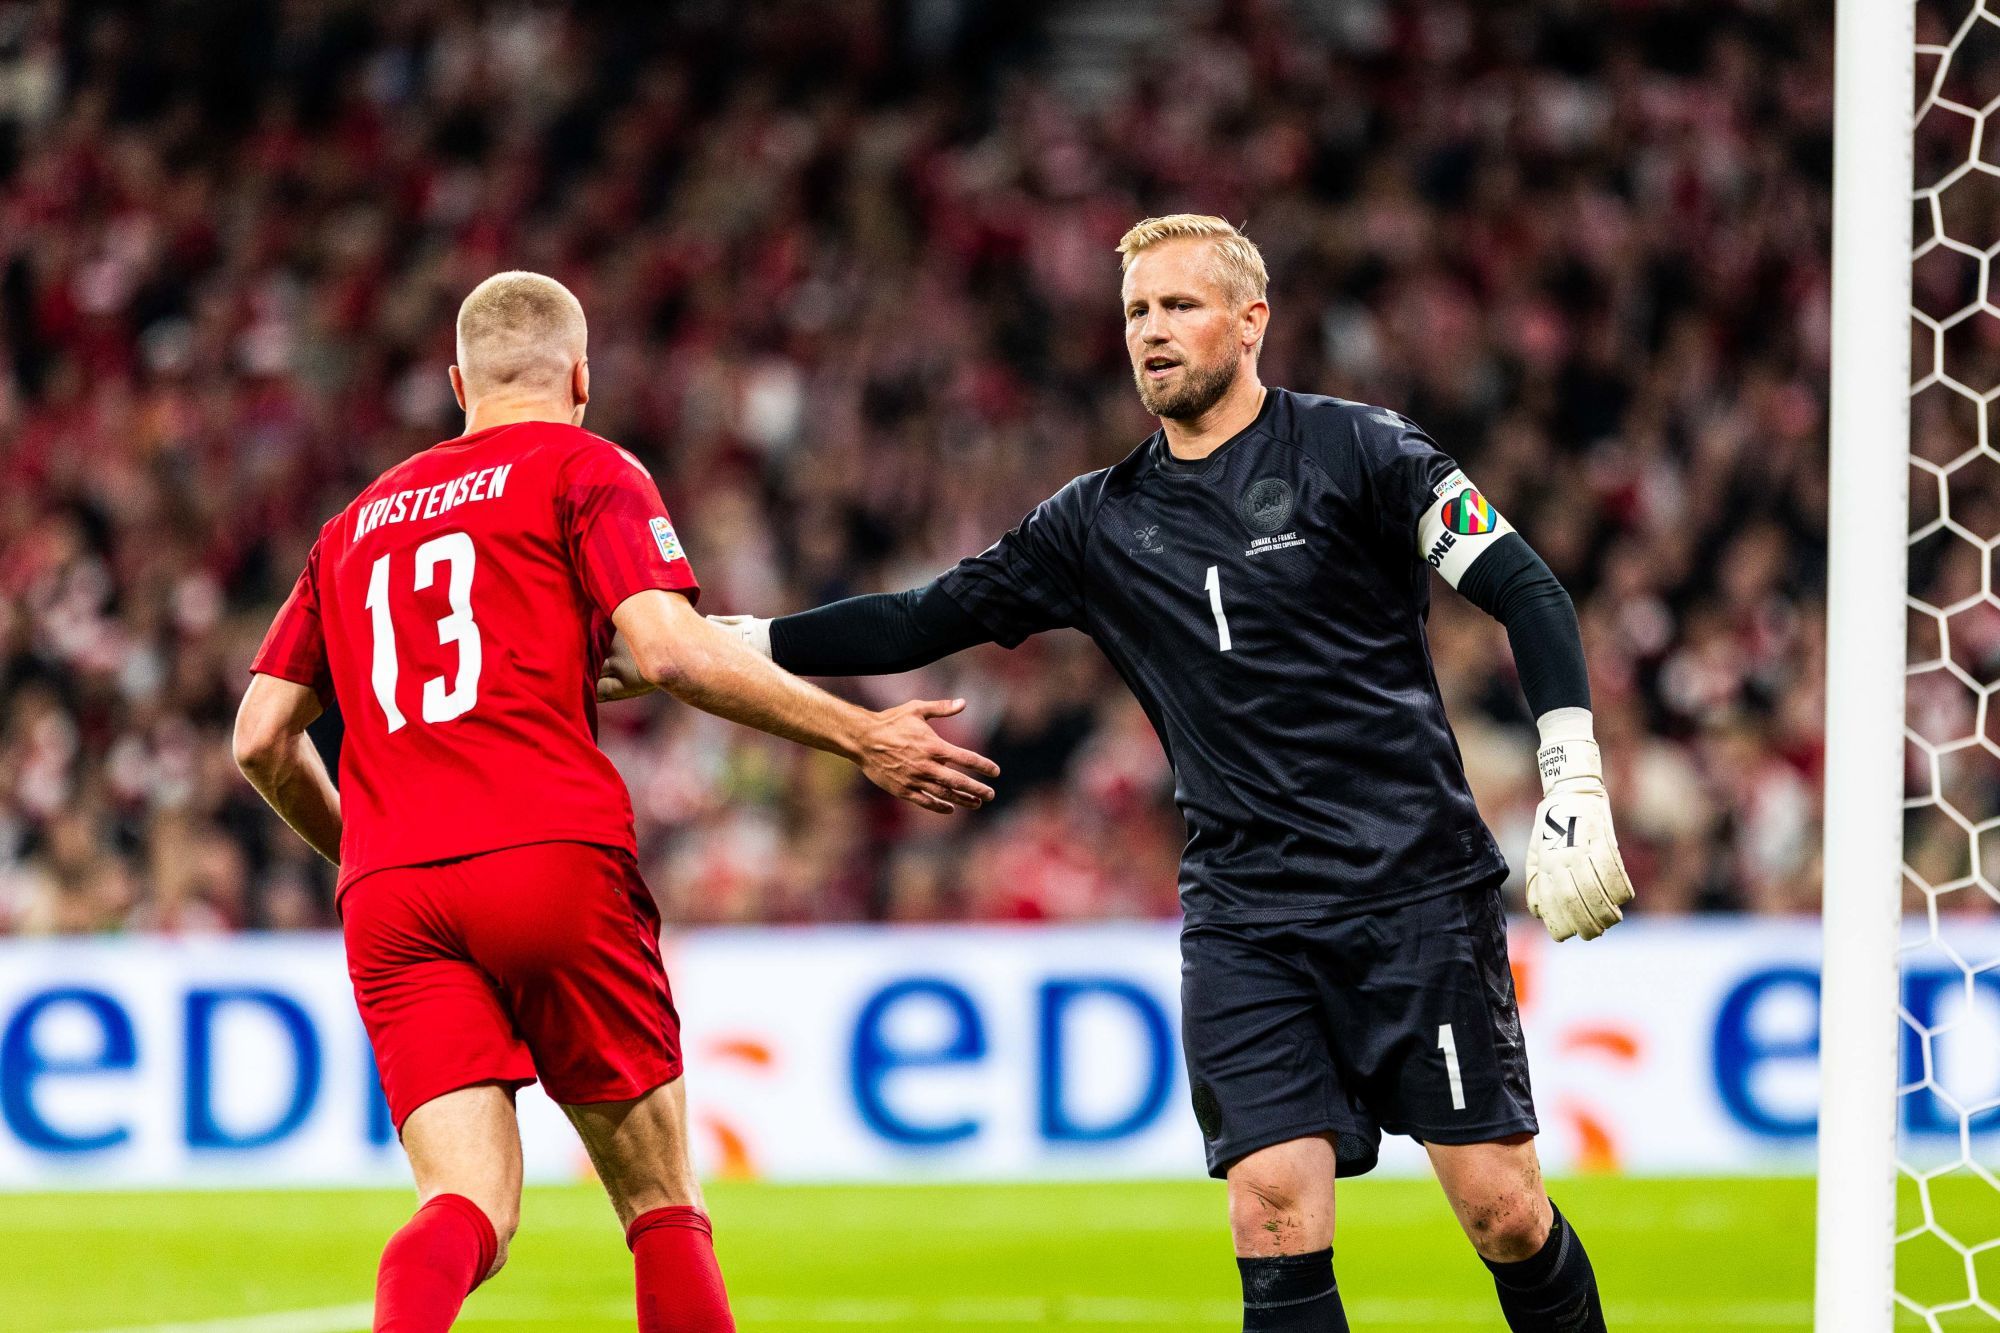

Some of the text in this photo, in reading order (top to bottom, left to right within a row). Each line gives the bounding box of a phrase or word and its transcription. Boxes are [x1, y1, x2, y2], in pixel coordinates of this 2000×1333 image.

[352, 463, 512, 543] KRISTENSEN
[1250, 536, 1272, 549] DENMARK
[1278, 531, 1297, 542] FRANCE
[1427, 530, 1457, 569] ONE
[365, 531, 482, 734] 13
[1204, 566, 1231, 651] 1
[1544, 766, 1561, 778] Max
[850, 975, 1176, 1146] eD
[1438, 1024, 1465, 1109] 1
